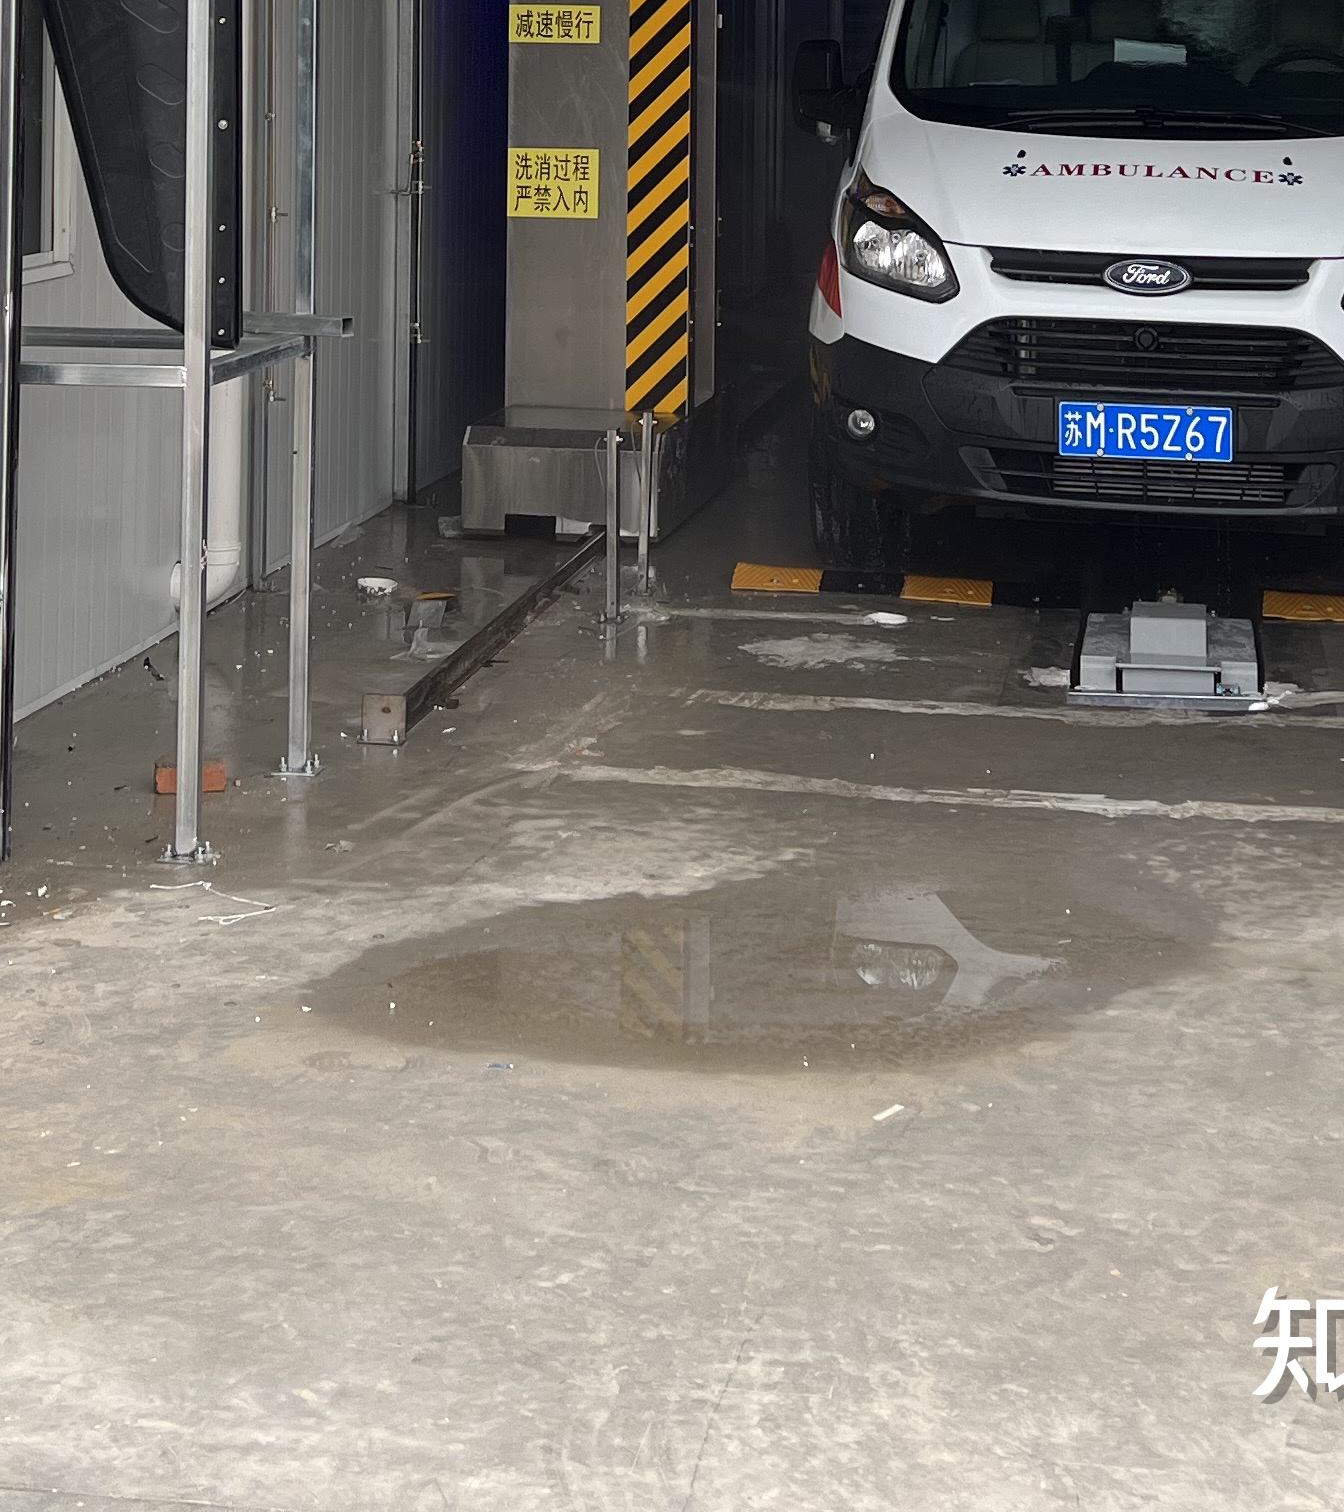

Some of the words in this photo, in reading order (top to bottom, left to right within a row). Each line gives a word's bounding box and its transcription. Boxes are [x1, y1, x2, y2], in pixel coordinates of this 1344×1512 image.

[515, 10, 594, 39] 减速慢行
[514, 154, 591, 182] 洗消过程
[1029, 163, 1275, 185] AMBULANCE
[514, 185, 589, 214] 严禁入内
[1122, 263, 1171, 285] Ford
